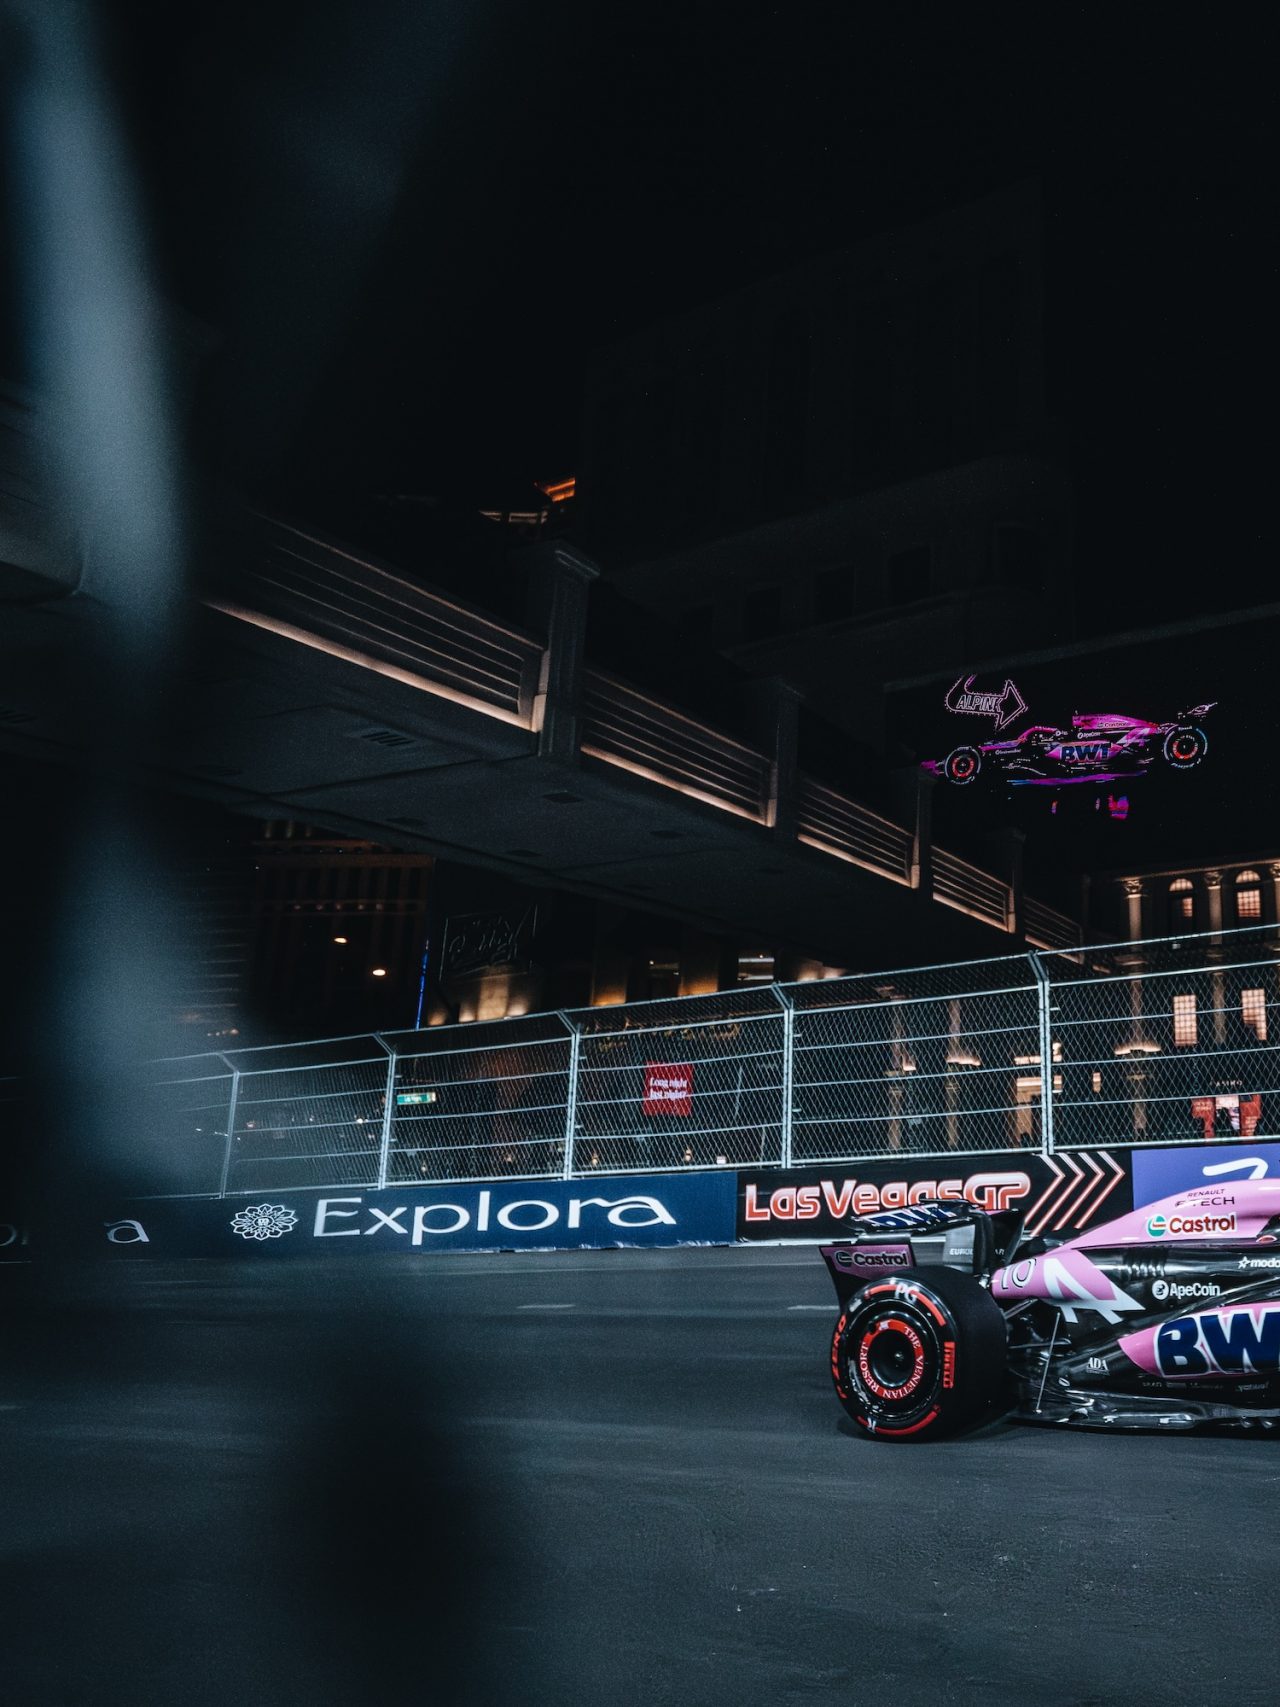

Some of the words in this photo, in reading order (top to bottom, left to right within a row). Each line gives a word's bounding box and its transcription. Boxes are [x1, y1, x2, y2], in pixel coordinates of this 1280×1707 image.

[1187, 1189, 1225, 1198] RENAULT
[313, 1190, 677, 1246] Explora
[1169, 1215, 1235, 1234] Castrol
[854, 1252, 908, 1266] Castrol
[1002, 1258, 1037, 1290] 10
[1170, 1283, 1221, 1300] ApeCoin
[904, 1326, 921, 1350] THE
[860, 1341, 880, 1394] RESORT
[883, 1354, 925, 1400] VENETIAN
